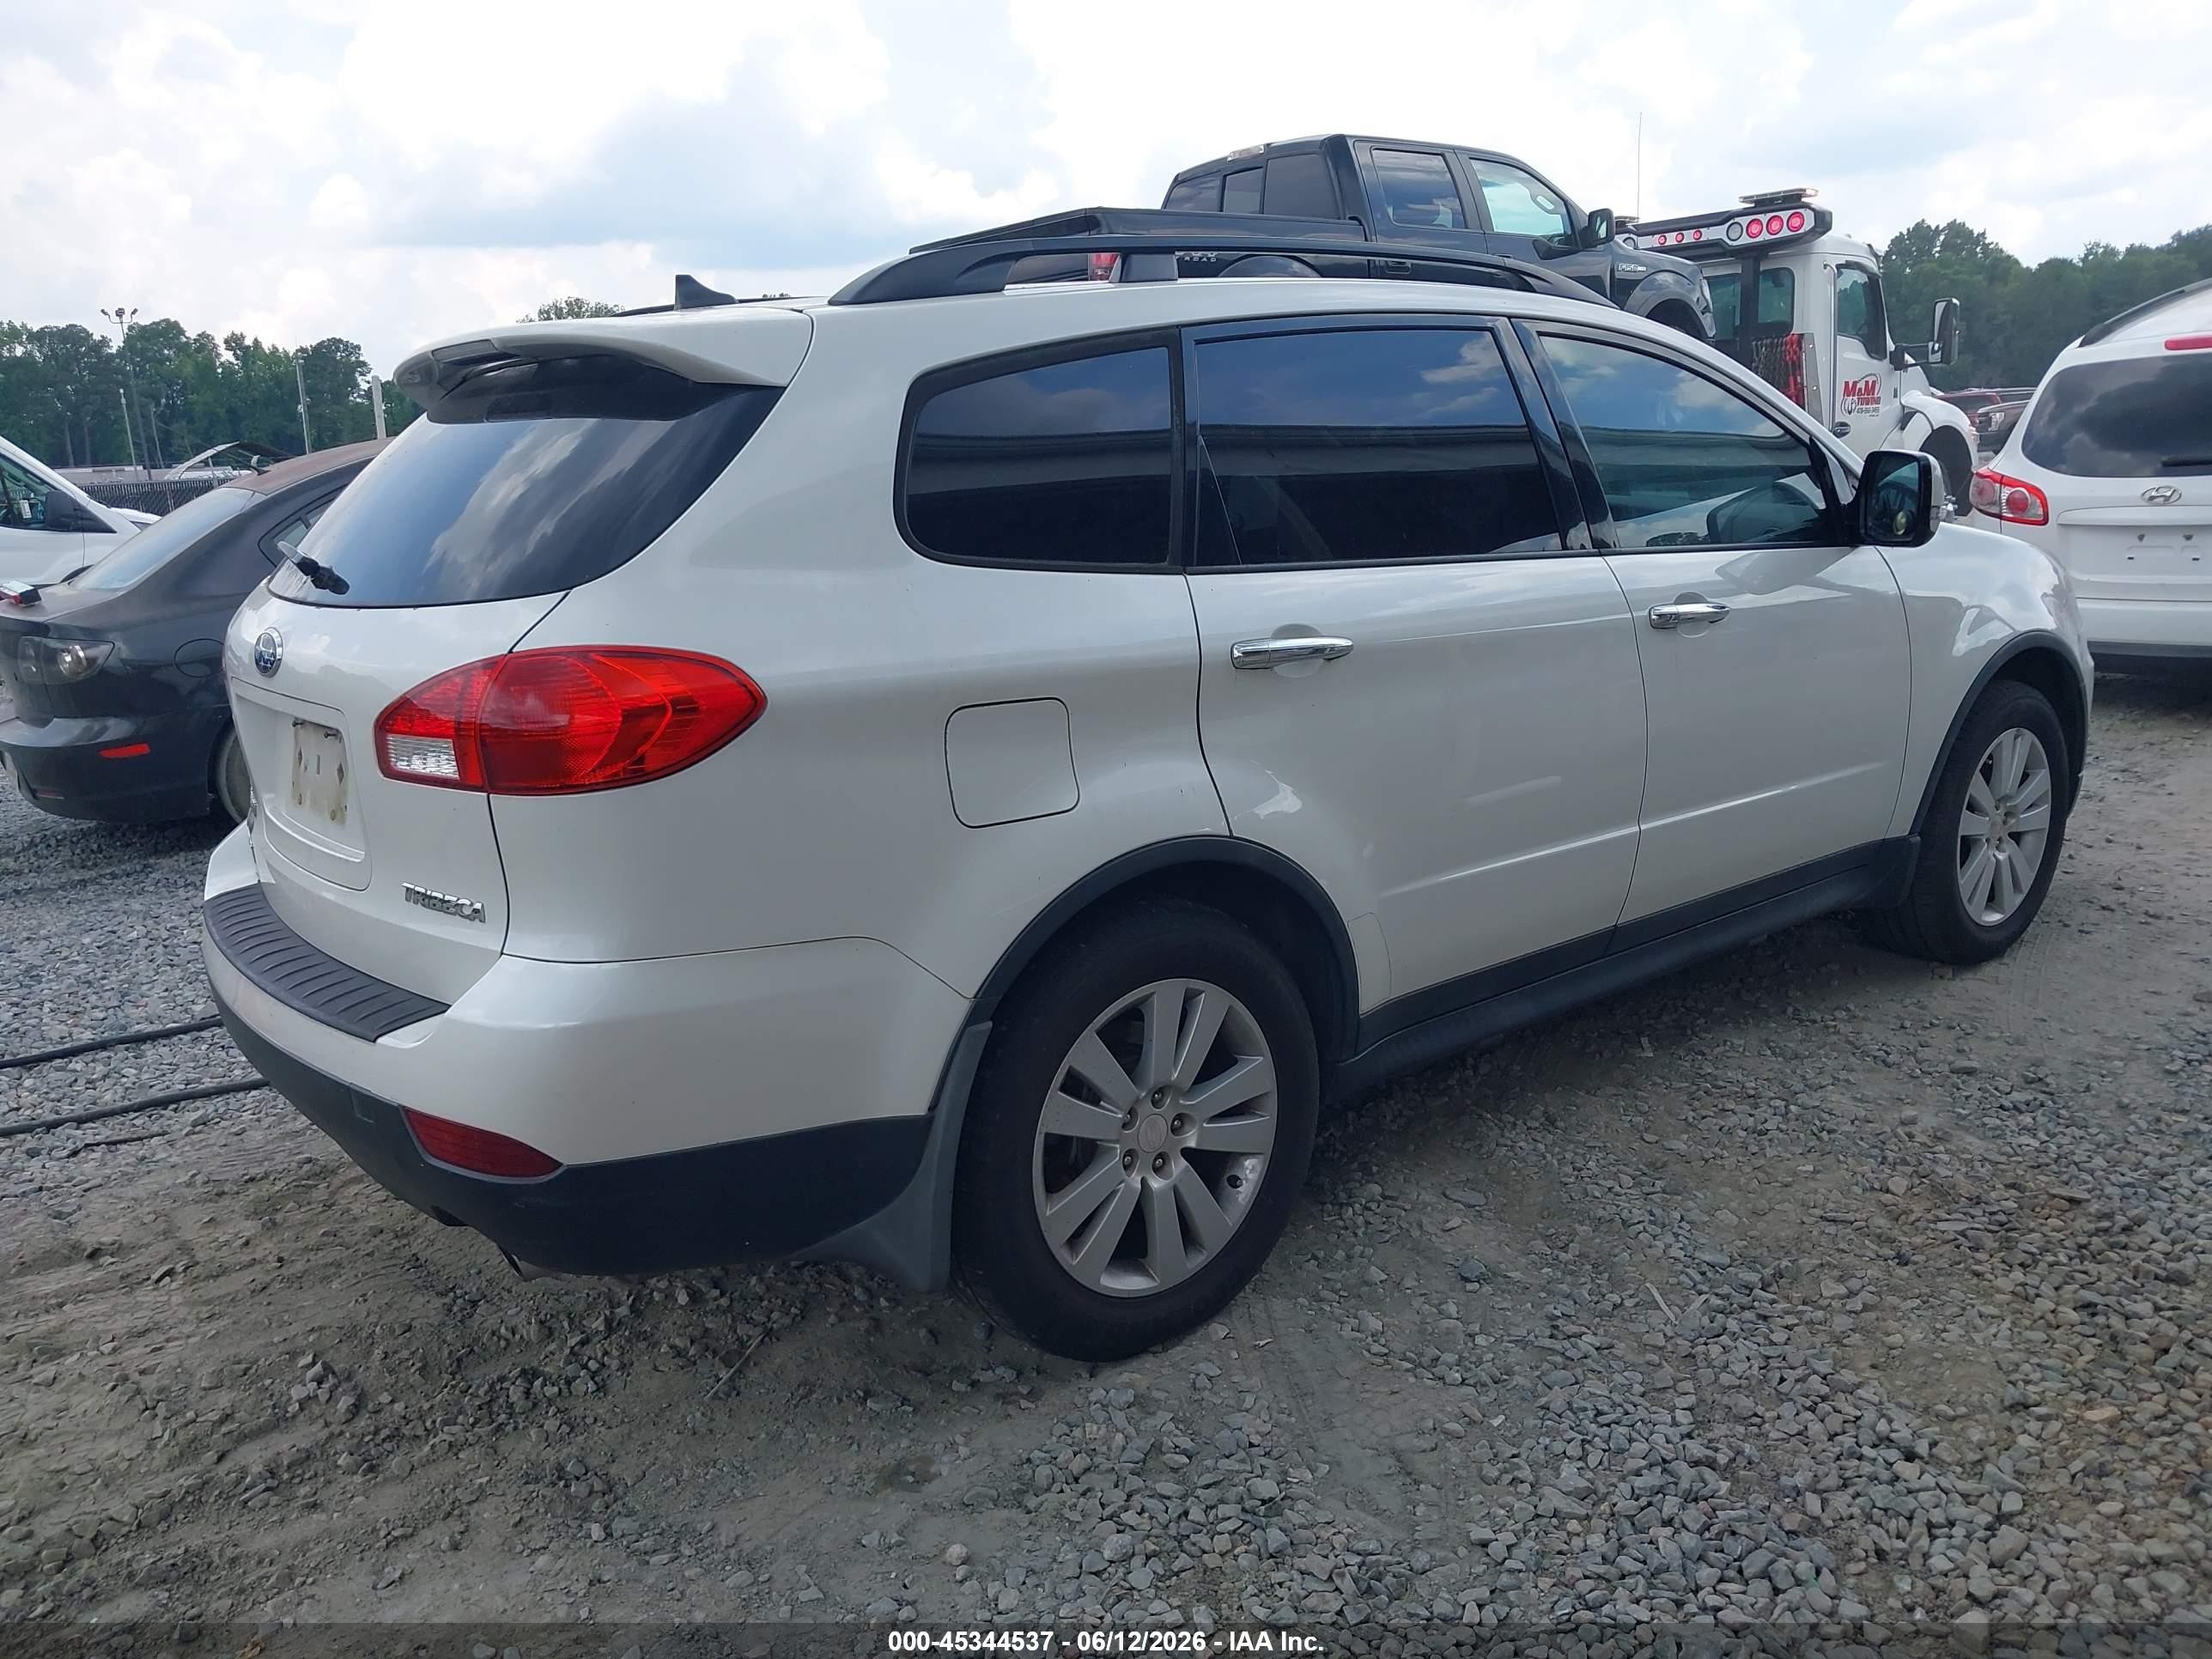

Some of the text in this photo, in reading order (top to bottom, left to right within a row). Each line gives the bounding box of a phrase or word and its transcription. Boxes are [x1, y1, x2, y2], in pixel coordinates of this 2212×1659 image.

[1844, 380, 1877, 397] M&M
[1856, 397, 1881, 405] TOWING
[401, 881, 486, 923] TRIBECA
